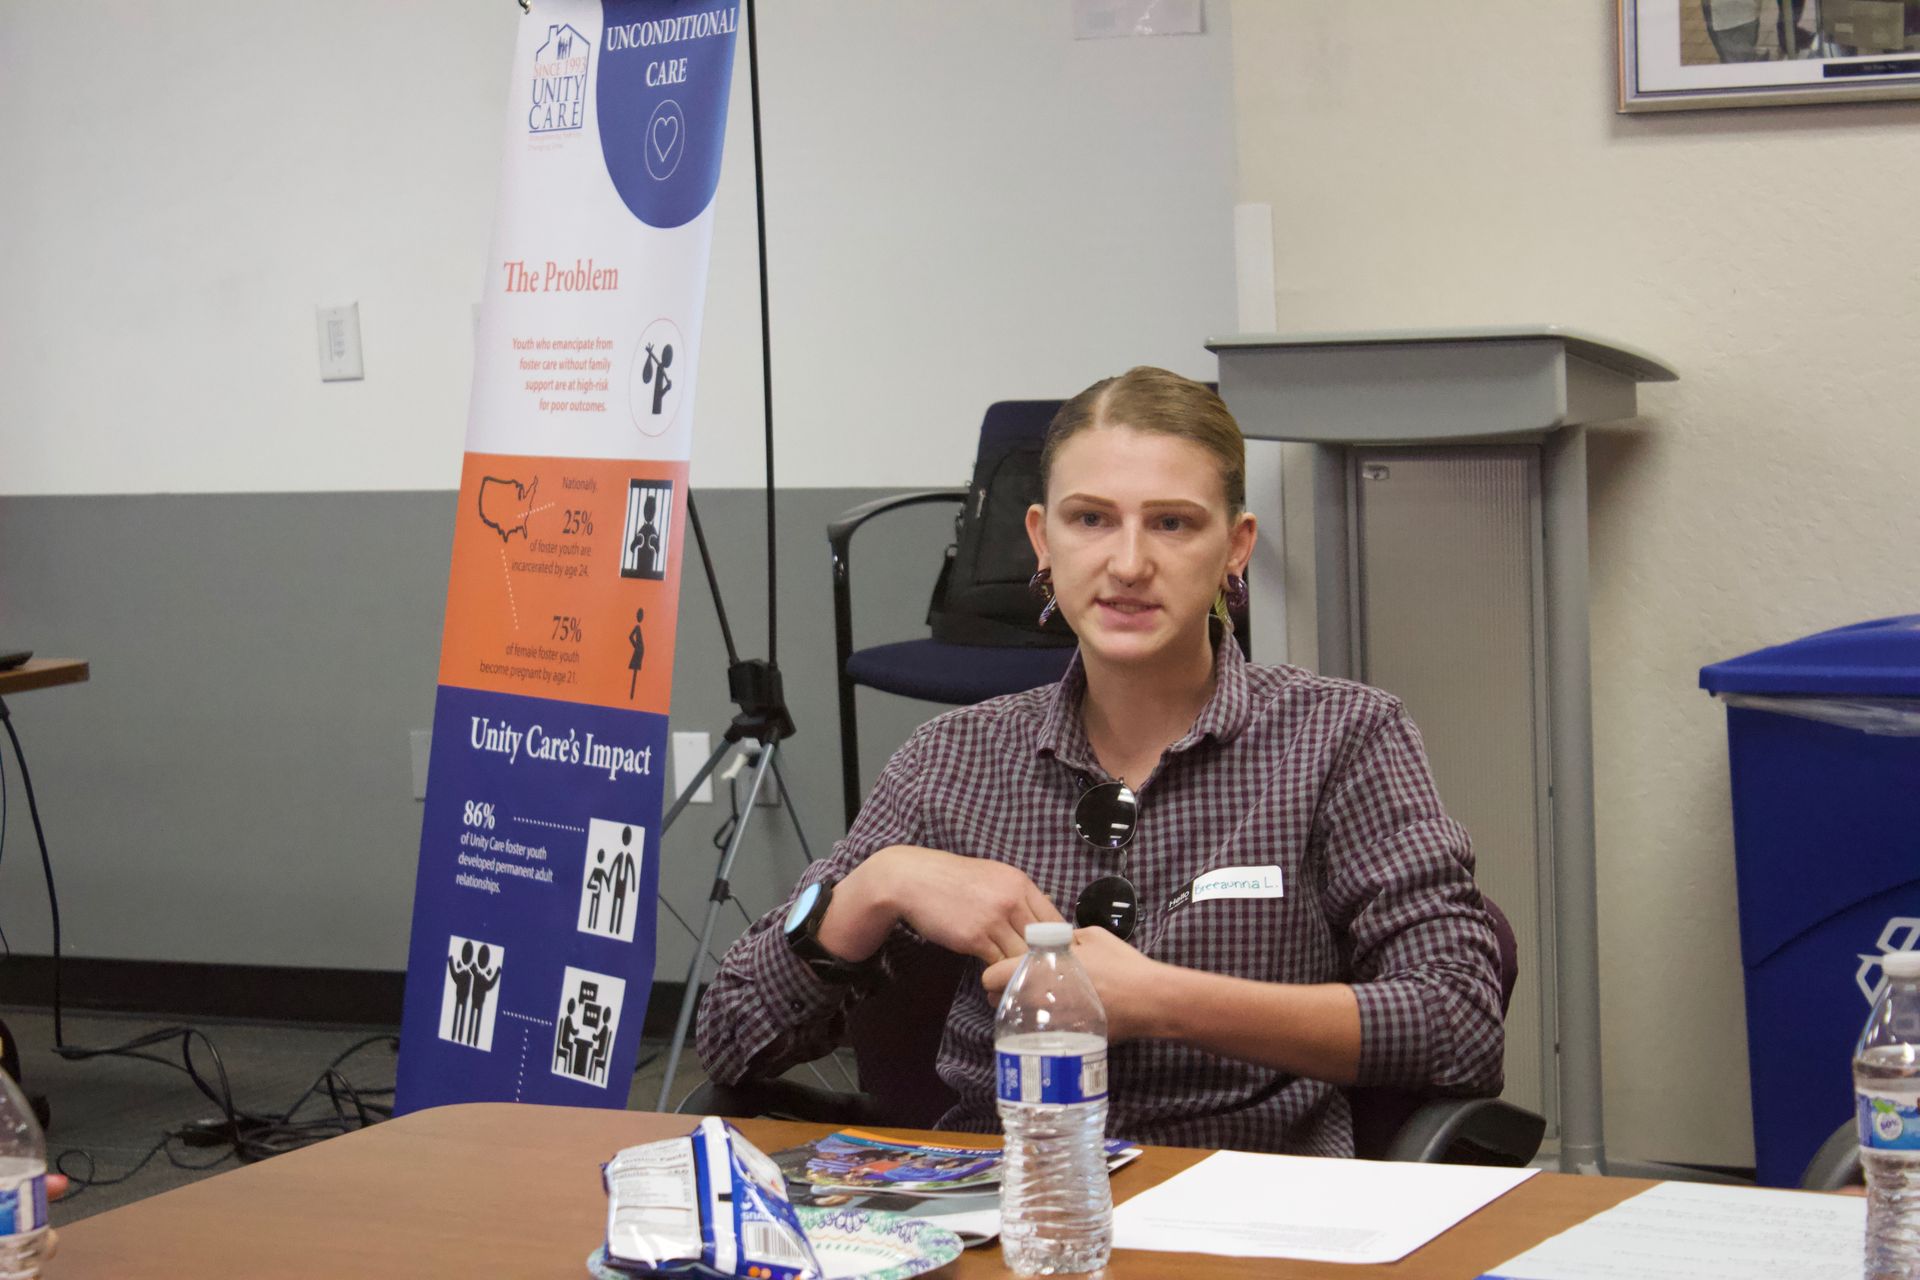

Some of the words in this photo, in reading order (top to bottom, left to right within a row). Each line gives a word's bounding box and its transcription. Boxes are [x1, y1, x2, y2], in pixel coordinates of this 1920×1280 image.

[607, 7, 738, 51] UNCONDITIONAL
[646, 58, 688, 87] CARE
[532, 74, 585, 105] UNITY
[529, 102, 580, 130] CARE
[503, 260, 540, 293] The
[543, 258, 620, 292] Problem
[512, 338, 535, 351] Youth
[536, 338, 551, 351] who
[552, 338, 595, 353] emancipate
[596, 336, 614, 350] from
[519, 358, 541, 371] foster
[543, 360, 557, 370] care
[559, 358, 586, 371] without
[588, 358, 611, 374] family
[526, 380, 553, 393] support
[555, 382, 567, 391] are
[568, 380, 576, 391] at
[577, 379, 609, 394] high-risk
[539, 399, 549, 411] for
[550, 401, 569, 413] poor
[570, 400, 606, 412] outcomes.
[562, 509, 593, 536] 25%
[530, 540, 539, 552] of
[539, 540, 558, 553] foster
[559, 545, 582, 556] youth
[583, 546, 592, 557] are
[512, 560, 554, 575] incarcerated
[555, 563, 563, 576] by
[564, 566, 577, 579] age
[551, 615, 582, 643] 75%
[506, 643, 515, 655] of
[515, 644, 538, 659] female
[538, 646, 558, 661] foster
[559, 649, 579, 664] youth
[480, 660, 509, 675] become
[509, 664, 543, 680] pregnant
[544, 668, 552, 682] by
[553, 672, 566, 685] age
[470, 716, 523, 765] Unity
[526, 725, 581, 765] Care's
[584, 733, 652, 781] Impact
[463, 800, 495, 830] 86%
[461, 833, 470, 845] of
[470, 833, 489, 849] Unity
[489, 836, 505, 851] Care
[505, 839, 526, 855] foster
[526, 843, 547, 860] youth
[458, 852, 495, 871] developed
[495, 859, 534, 878] permanent
[535, 867, 554, 883] adult
[456, 873, 500, 894] relationships.
